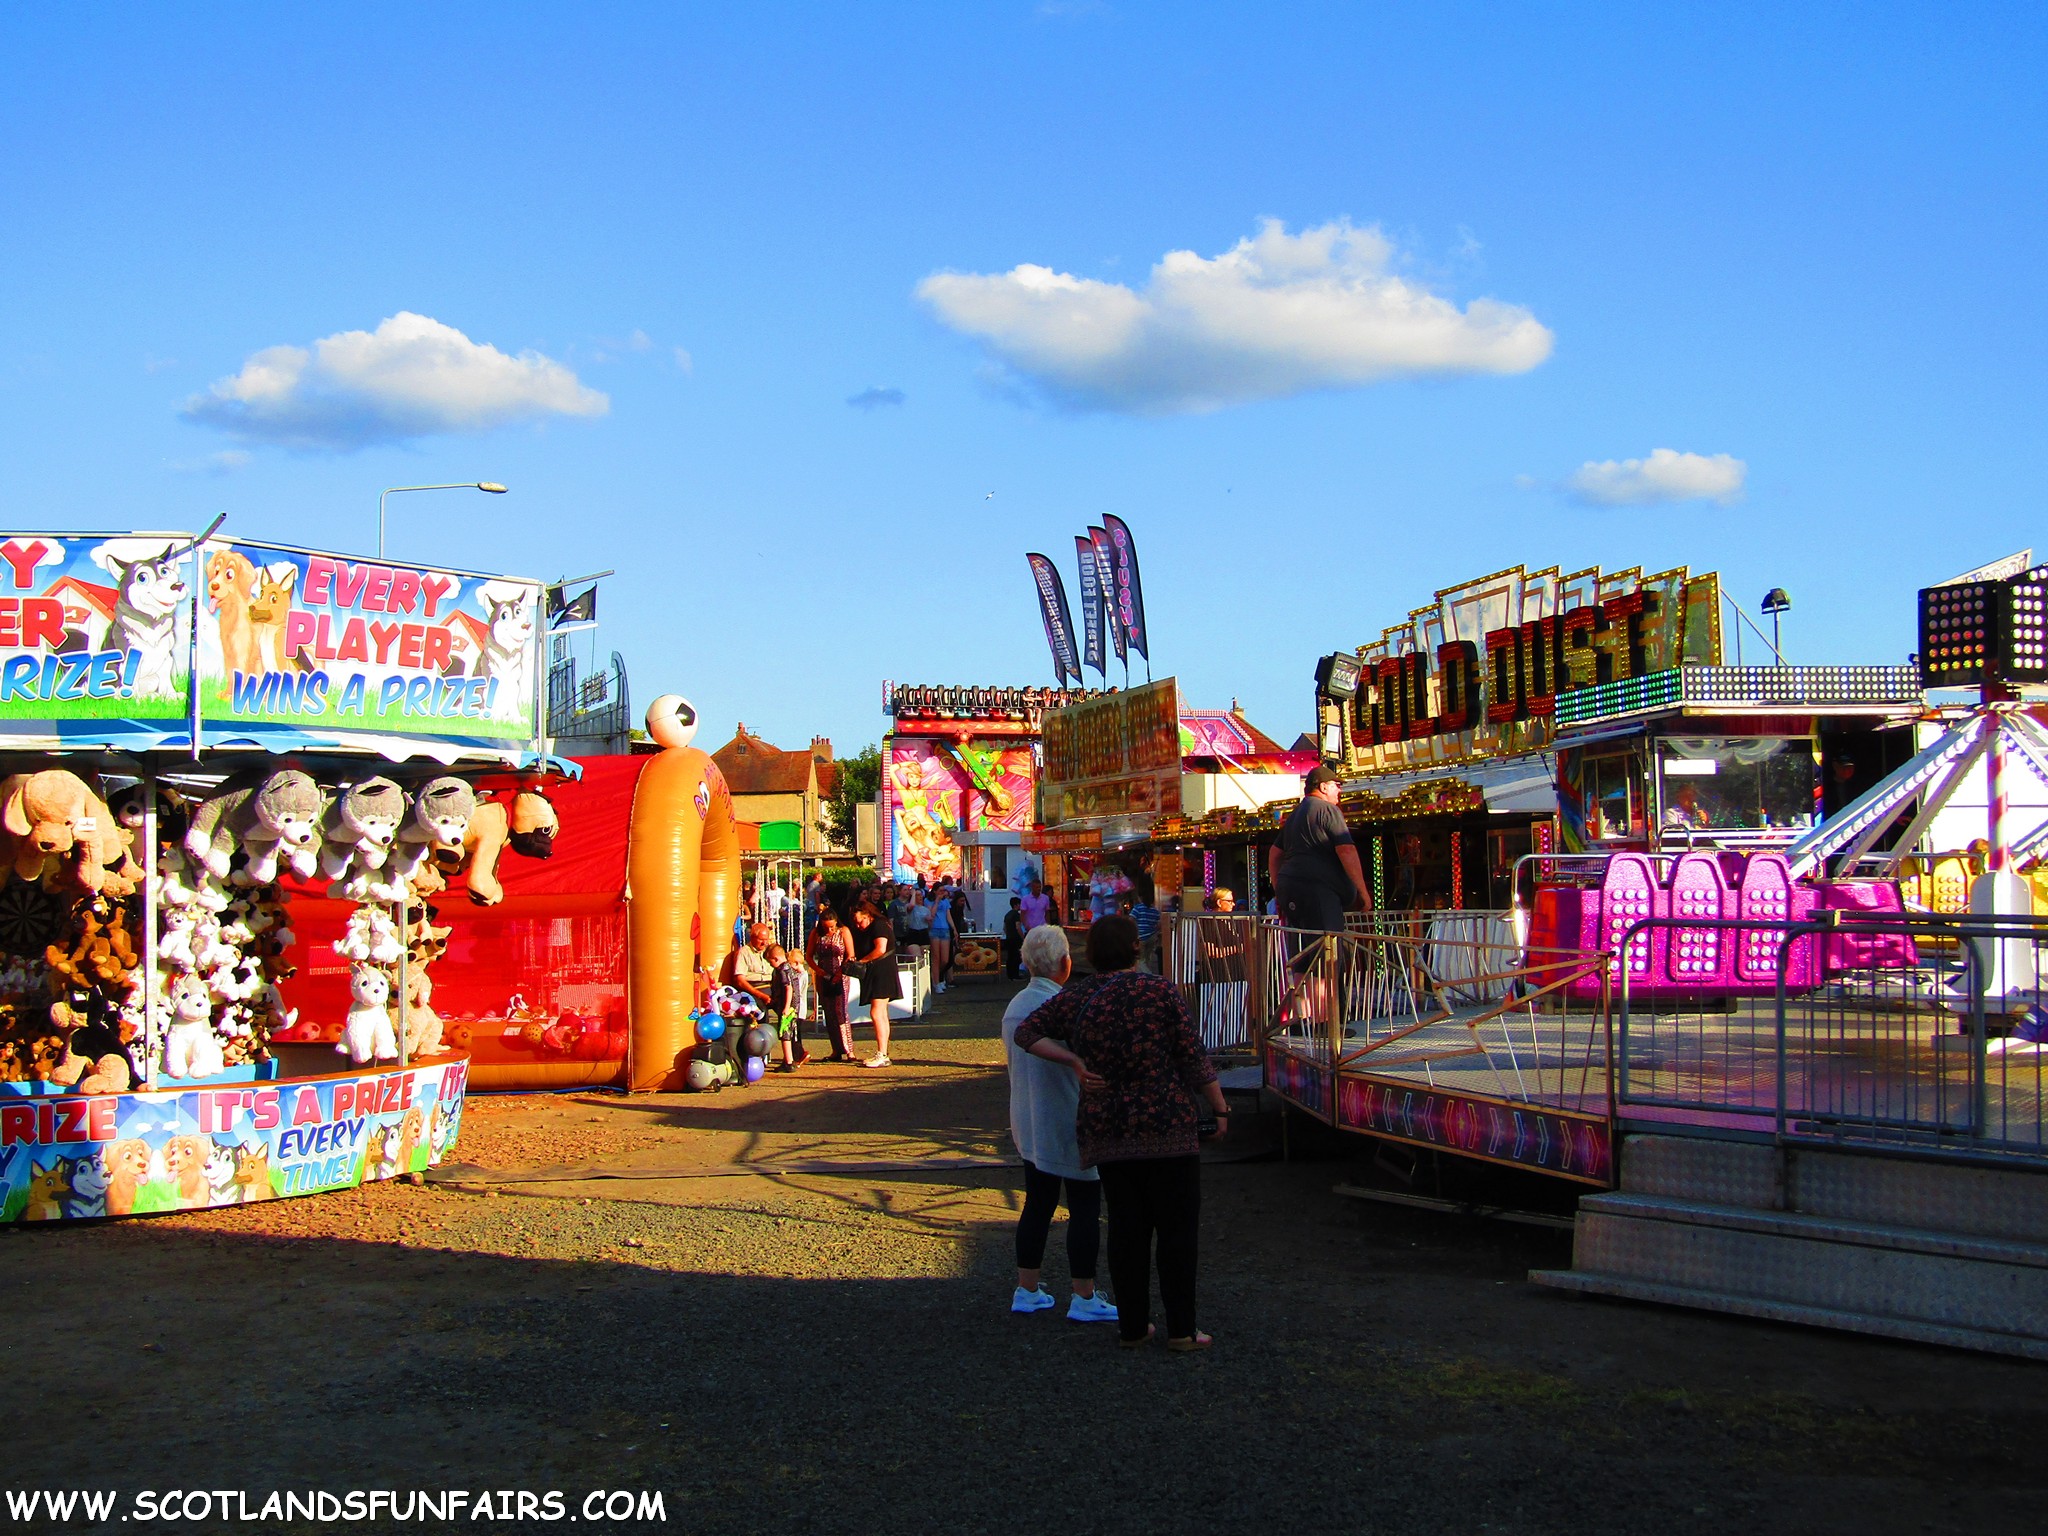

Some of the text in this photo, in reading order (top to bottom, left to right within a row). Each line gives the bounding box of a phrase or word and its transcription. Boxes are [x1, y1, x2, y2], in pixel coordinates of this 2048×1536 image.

[302, 556, 451, 618] EVERY
[285, 610, 451, 673] PLAYER
[0, 648, 142, 702] RIZE!
[232, 669, 499, 719] WINS A PRIZE!
[1349, 592, 1654, 747] GOLD DUST
[0, 1098, 118, 1146] RIZE
[199, 1090, 280, 1134] IT'S
[293, 1089, 322, 1126] A
[333, 1073, 415, 1120] PRIZE
[277, 1117, 366, 1160] EVERY
[281, 1151, 359, 1194] TIME!
